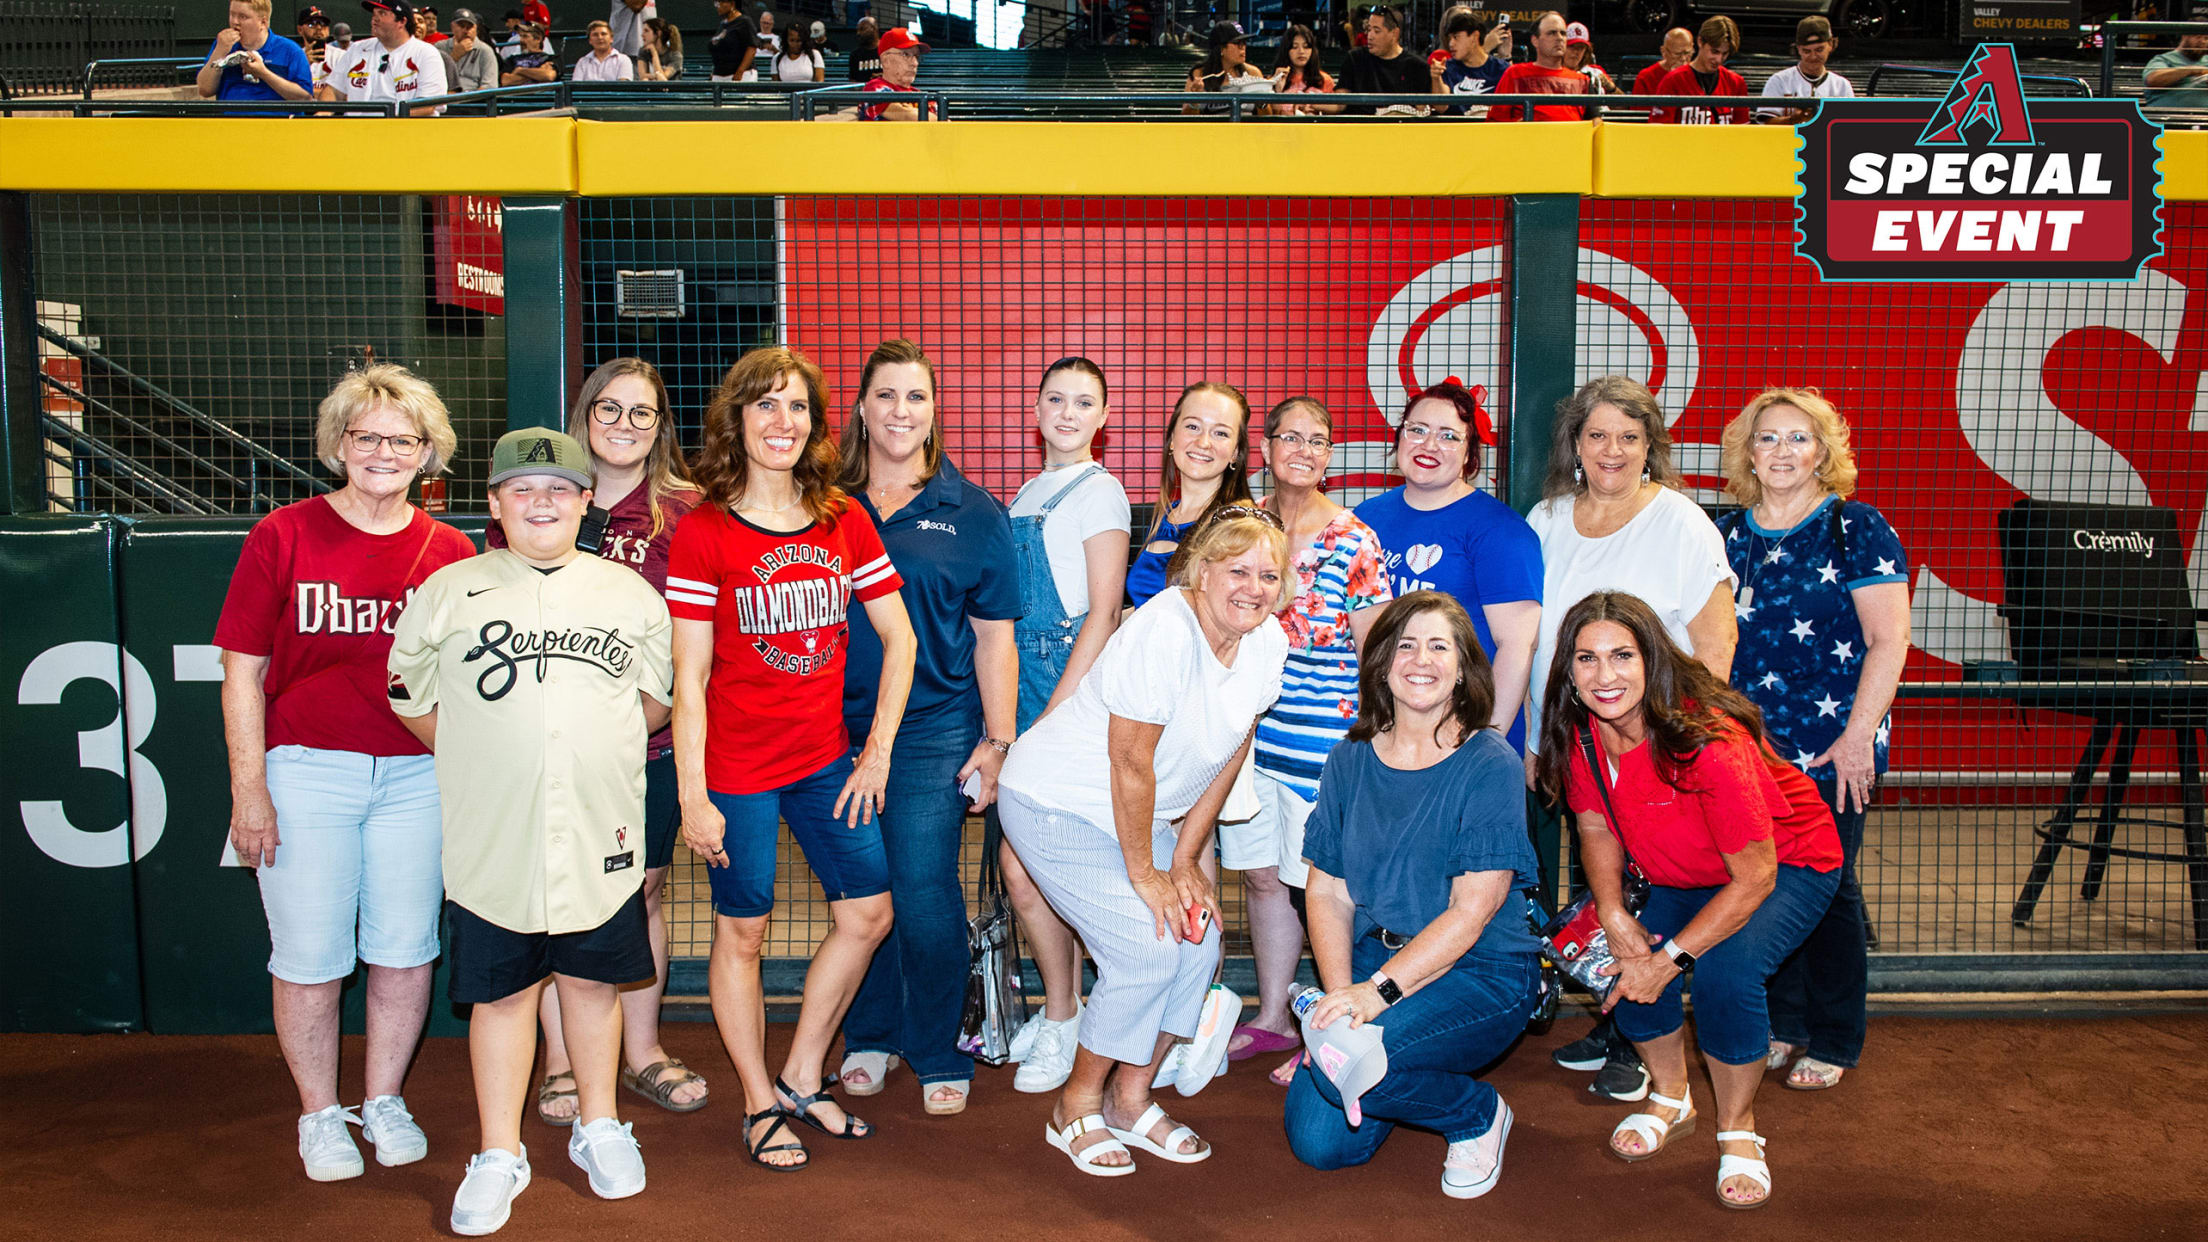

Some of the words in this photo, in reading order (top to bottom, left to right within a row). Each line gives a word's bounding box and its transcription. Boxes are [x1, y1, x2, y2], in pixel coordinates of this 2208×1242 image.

[1973, 17, 2012, 28] CHEVY
[2016, 18, 2070, 30] DEALERS
[1974, 8, 1999, 16] VALLEY
[752, 544, 842, 584] ARIZONA
[462, 620, 634, 701] Serpientes
